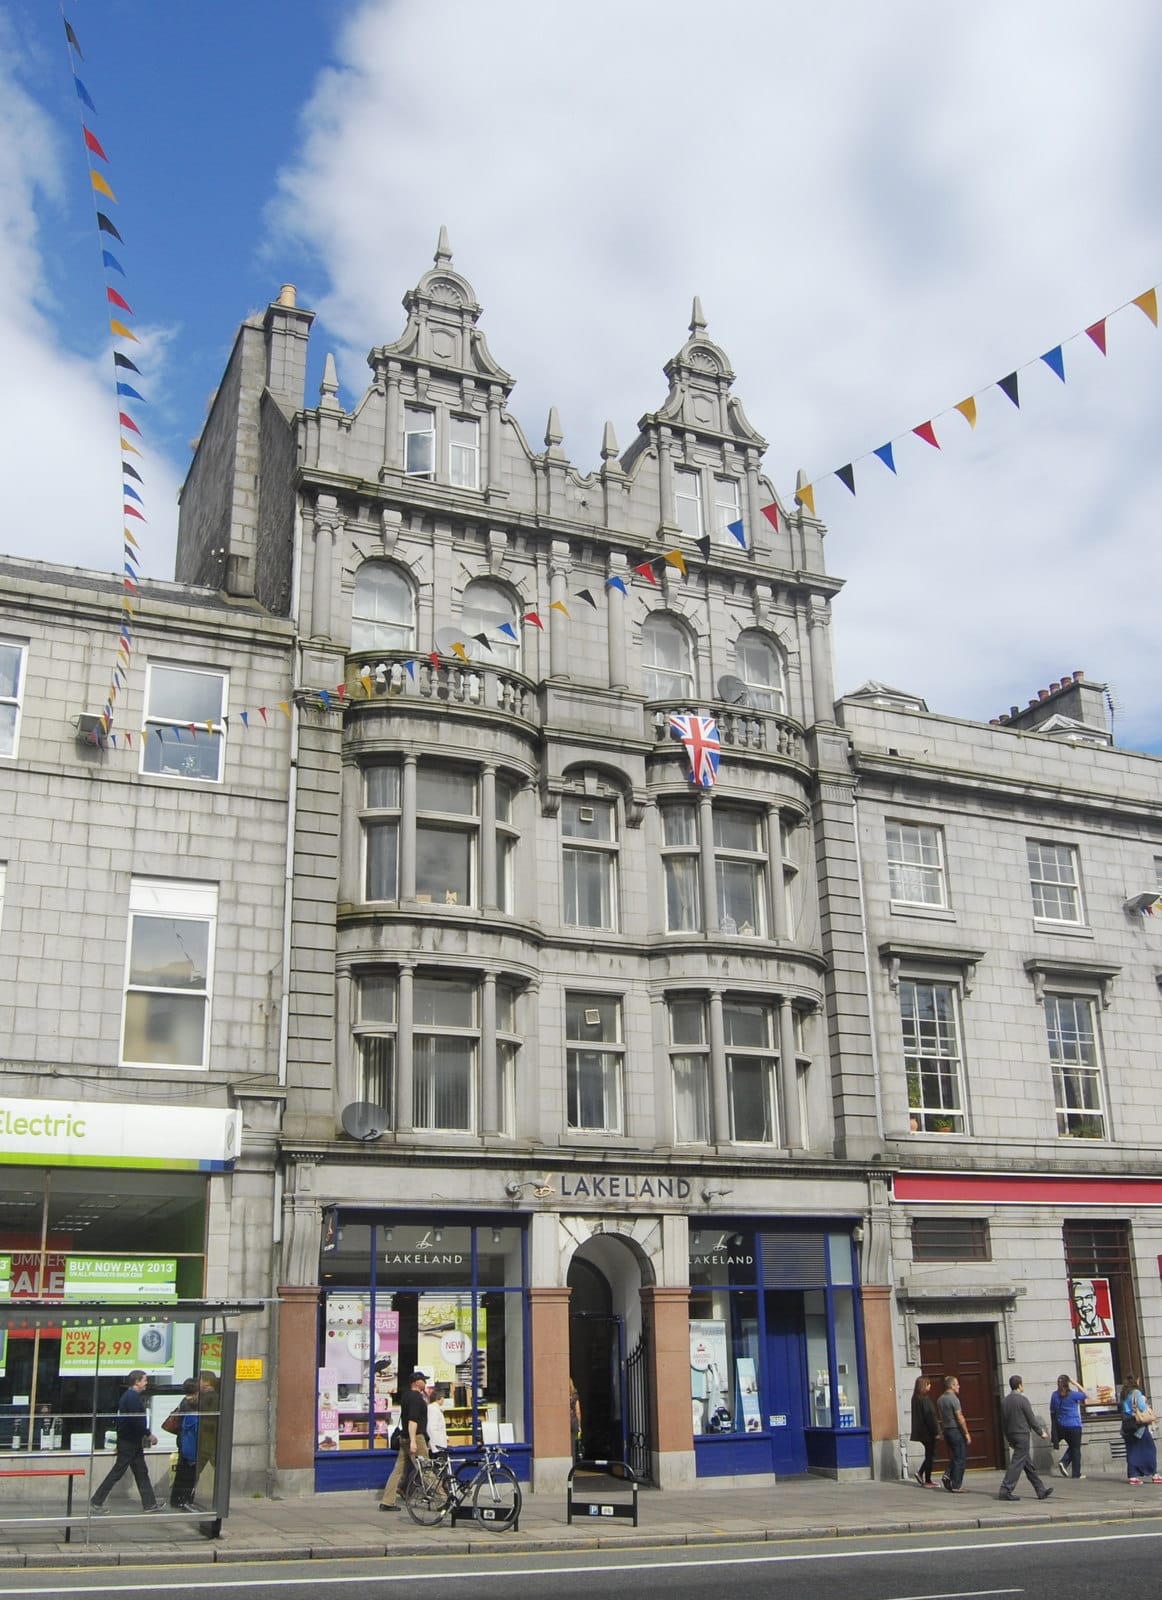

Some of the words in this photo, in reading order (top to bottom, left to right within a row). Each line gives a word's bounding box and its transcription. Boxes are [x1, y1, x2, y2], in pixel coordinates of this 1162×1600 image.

[561, 1175, 691, 1199] LAKELAND
[11, 1253, 65, 1267] UMMER
[385, 1254, 463, 1264] LAKELAND
[688, 1255, 753, 1264] LAKELAND
[69, 1261, 92, 1271] BUY
[95, 1262, 121, 1272] NOW
[124, 1263, 144, 1272] PAY
[66, 1331, 91, 1340] NOW
[65, 1341, 132, 1355] £329.99
